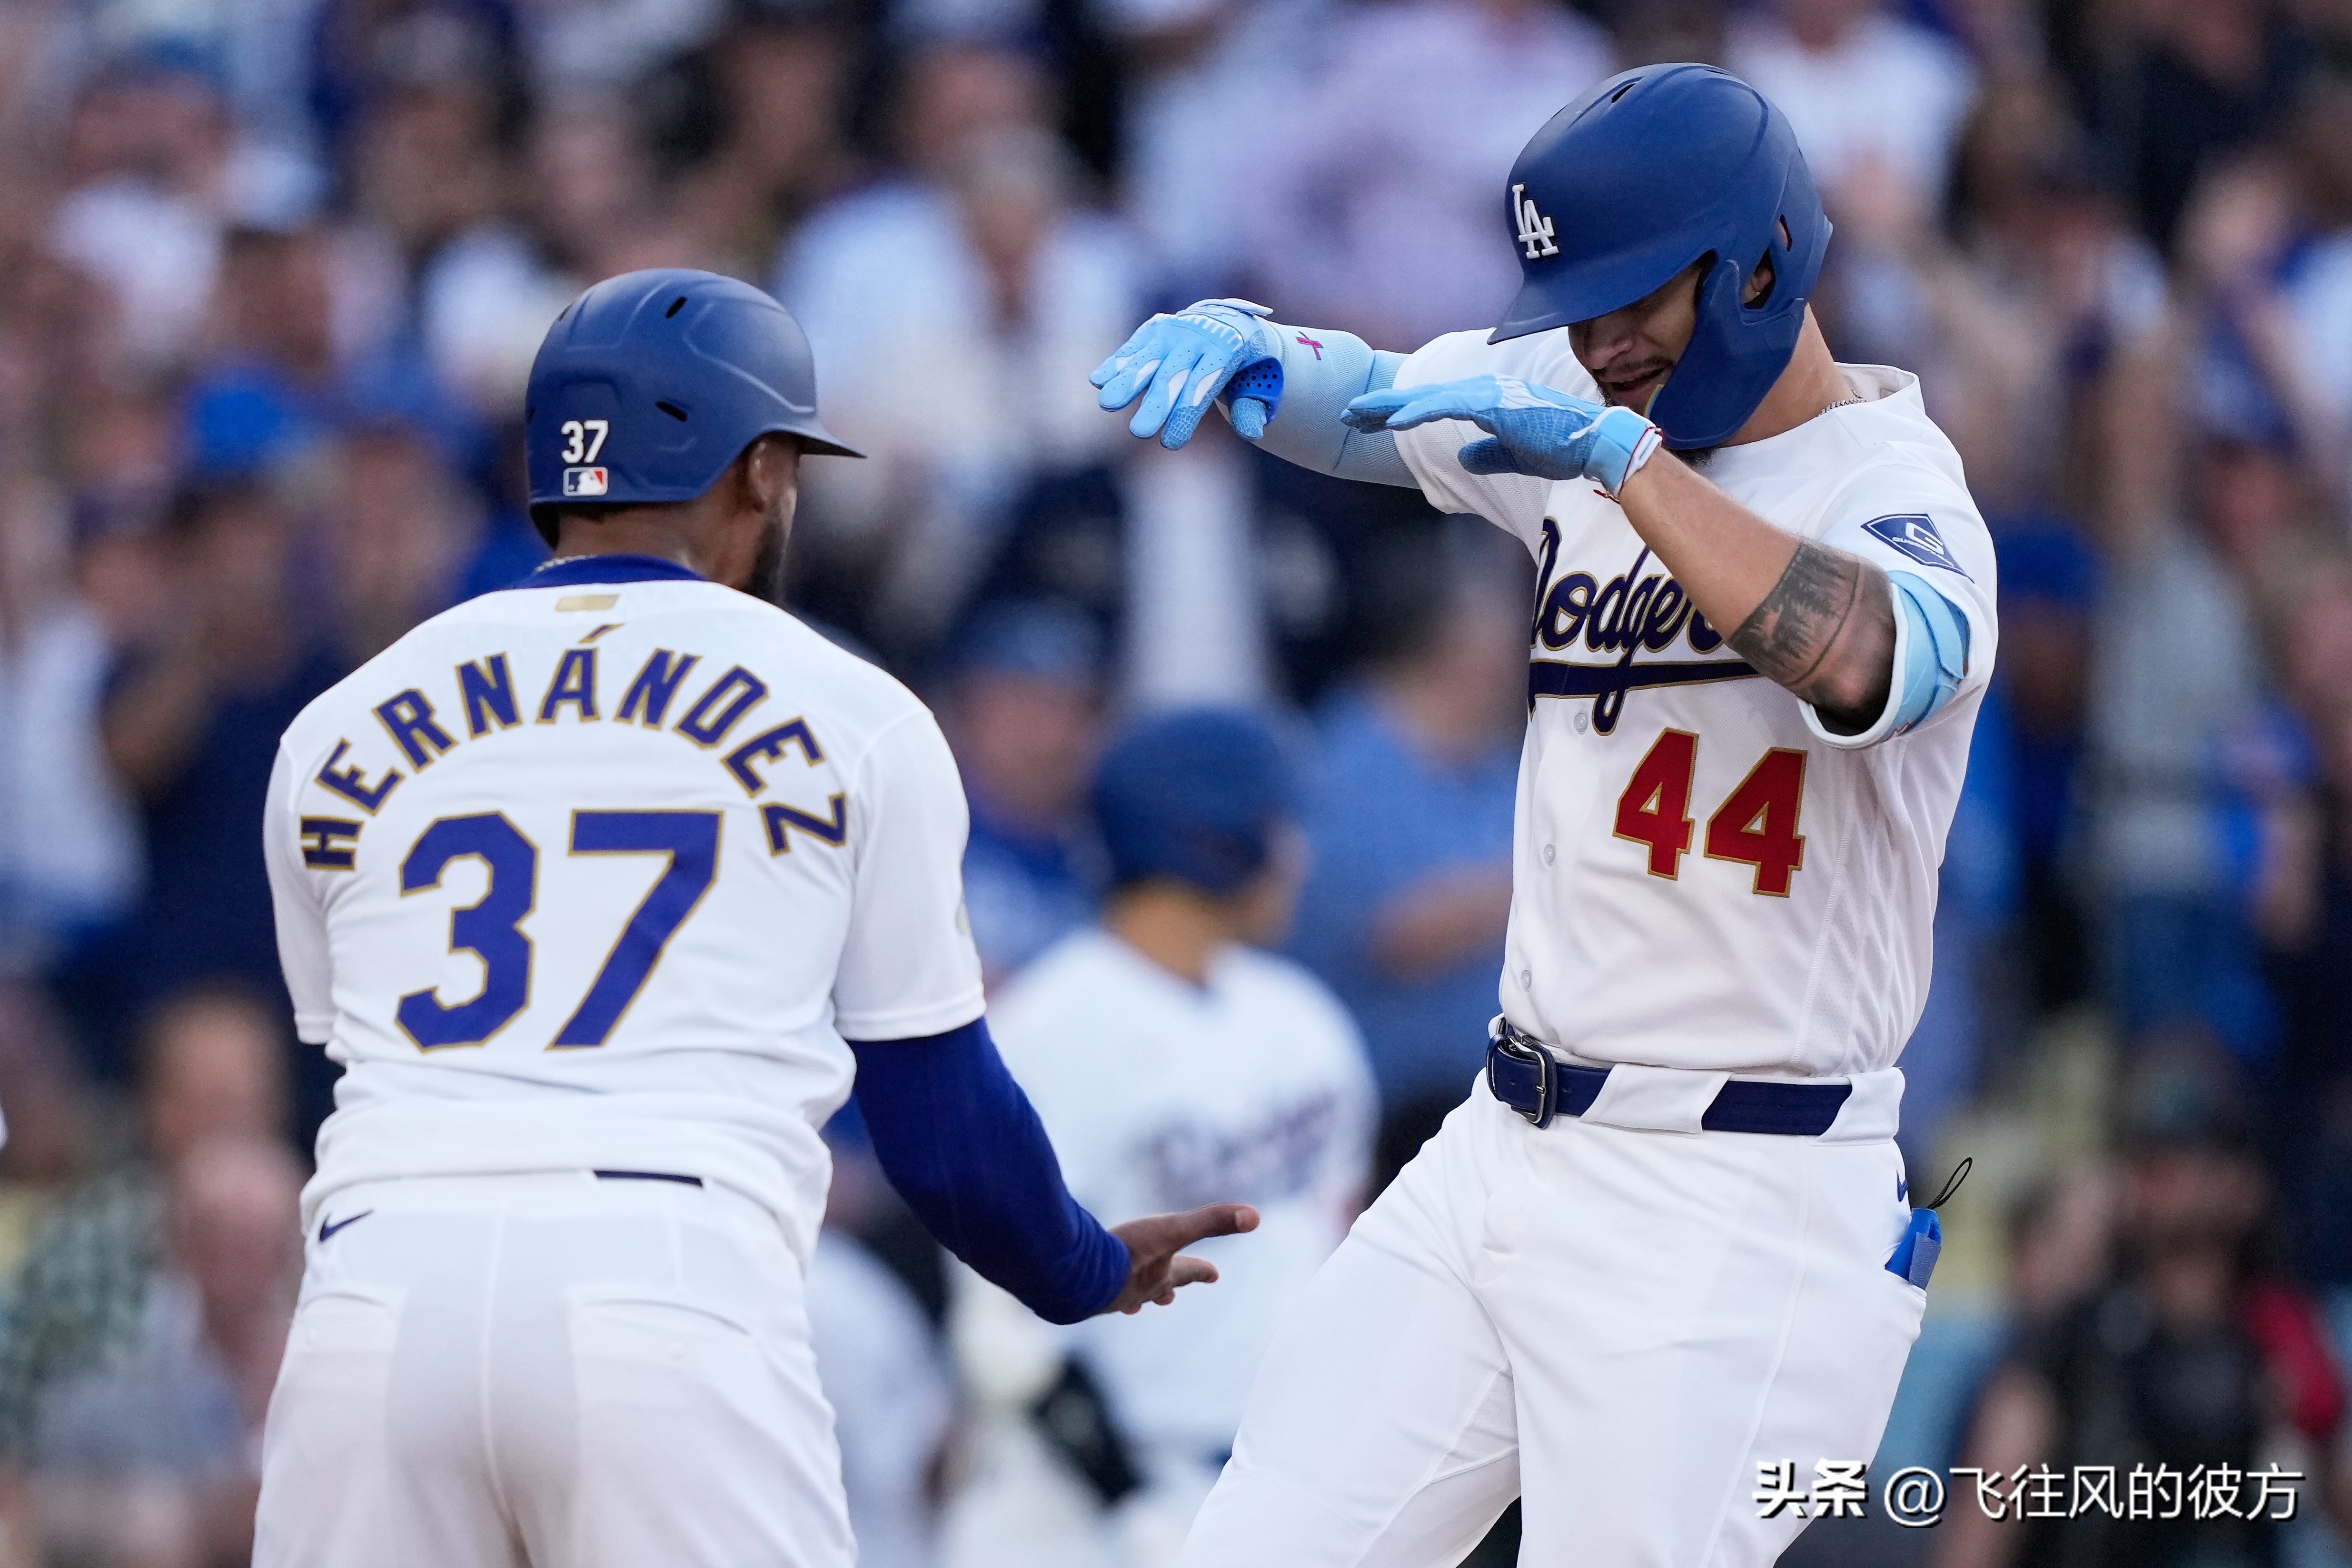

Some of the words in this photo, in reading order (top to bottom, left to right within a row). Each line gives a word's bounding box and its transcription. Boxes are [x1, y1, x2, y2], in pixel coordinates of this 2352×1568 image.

[1512, 184, 1559, 259] LA
[561, 420, 608, 463] 37
[300, 624, 847, 871] HERNÁNDEZ
[1612, 727, 1807, 898] 44
[395, 810, 724, 1053] 37
